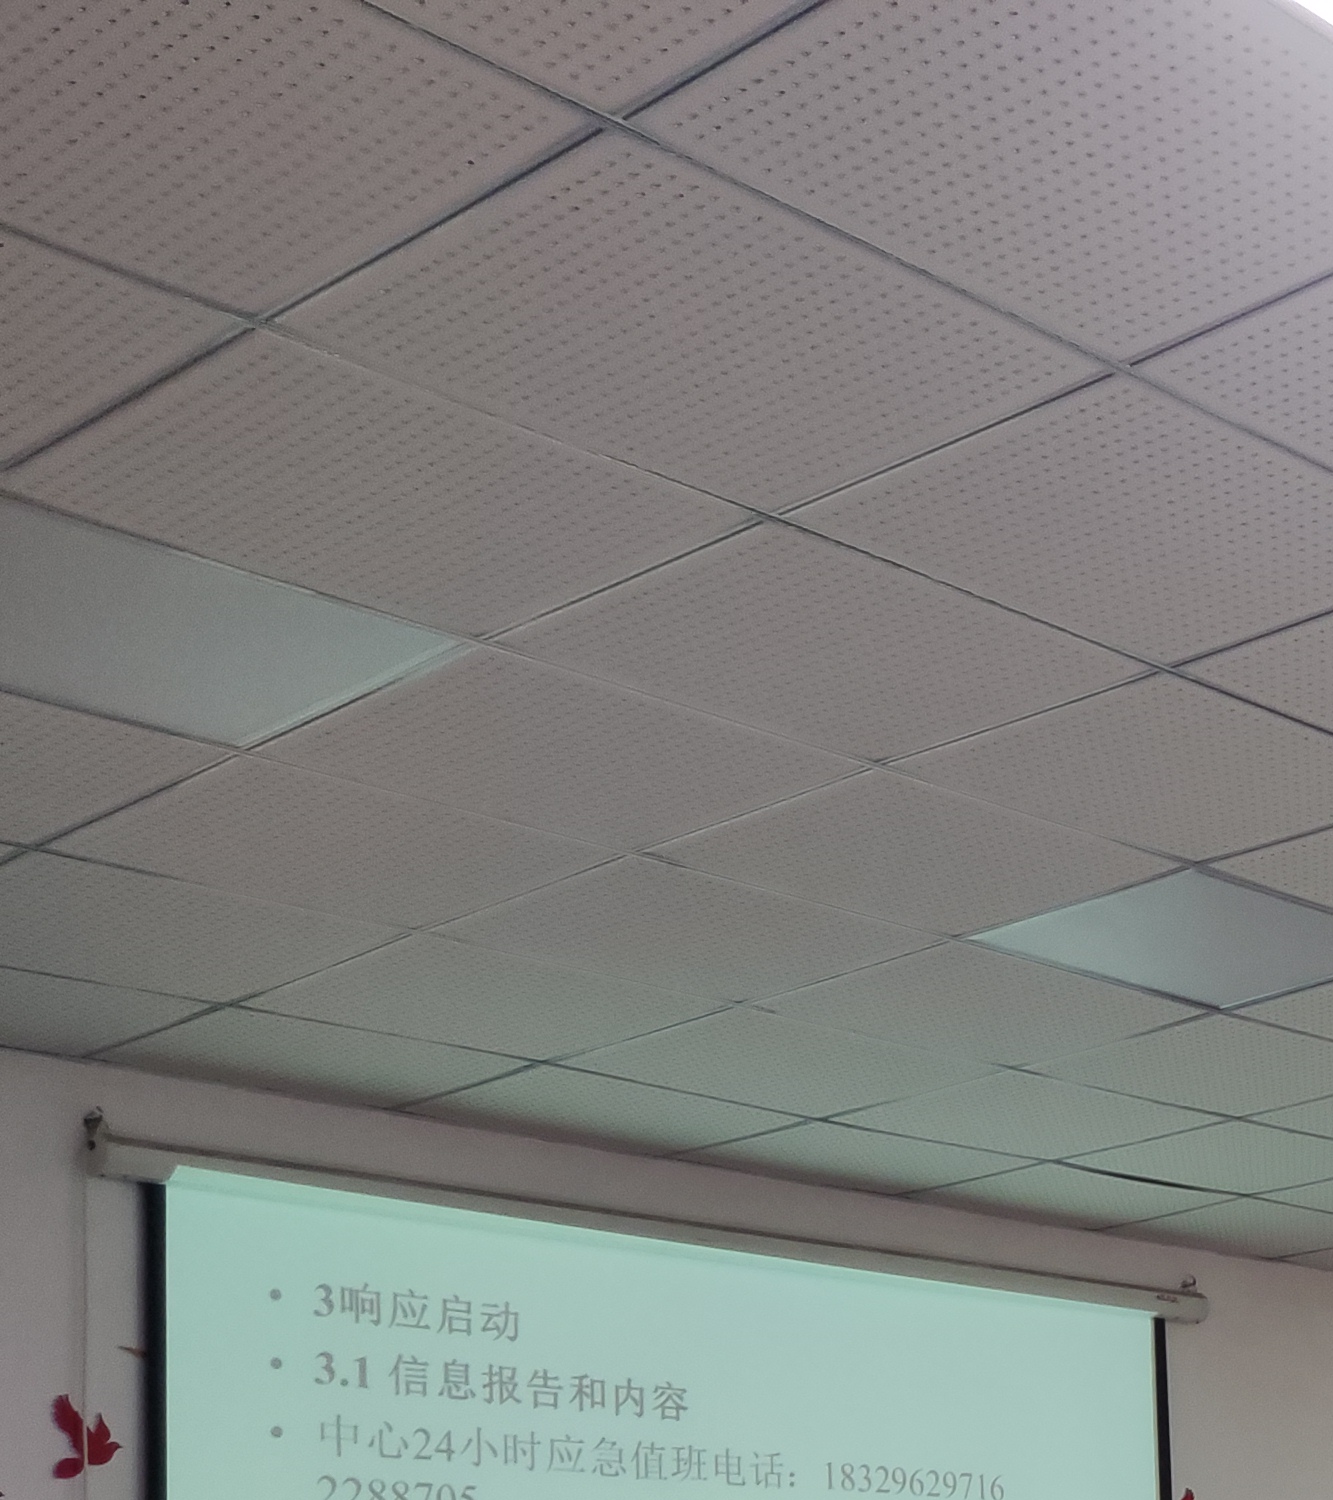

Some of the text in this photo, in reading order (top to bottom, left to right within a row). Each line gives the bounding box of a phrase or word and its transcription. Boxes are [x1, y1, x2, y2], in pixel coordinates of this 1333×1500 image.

[313, 1282, 520, 1343] 3响应启动
[313, 1351, 689, 1422] 3.1 信息报告和内容
